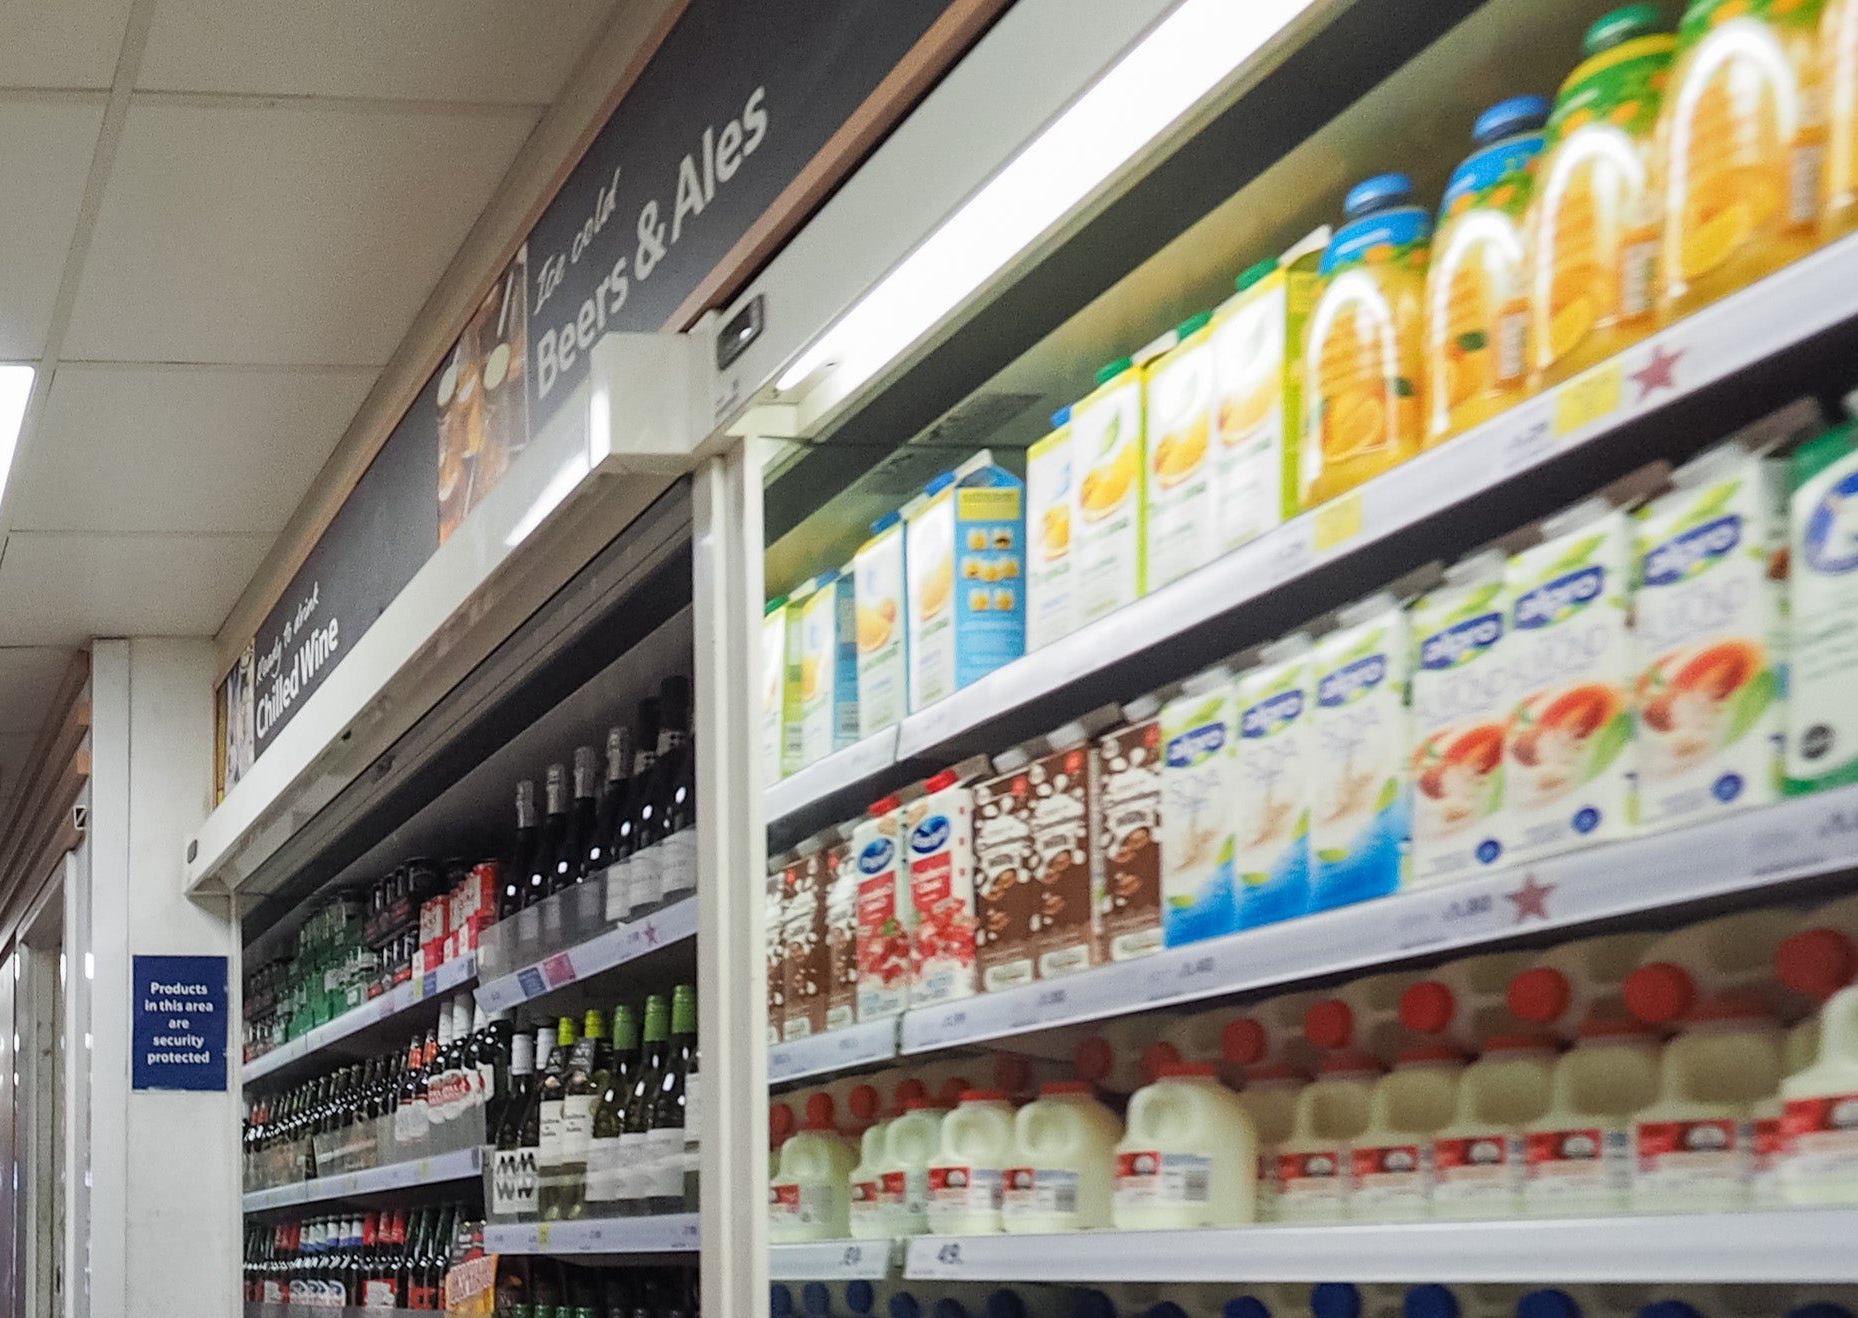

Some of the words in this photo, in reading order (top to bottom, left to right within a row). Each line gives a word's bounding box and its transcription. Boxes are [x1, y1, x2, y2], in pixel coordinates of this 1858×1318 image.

[570, 166, 622, 264] cold
[536, 255, 630, 400] Beers
[634, 199, 669, 282] &
[670, 85, 768, 246] Ales
[256, 652, 300, 739] Chilled
[300, 617, 339, 686] Wine
[150, 982, 208, 995] Products
[144, 999, 158, 1012] in
[159, 999, 184, 1012] this
[185, 1002, 214, 1012] area
[168, 1018, 190, 1029] are
[152, 1034, 205, 1048] security
[147, 1051, 210, 1065] protected
